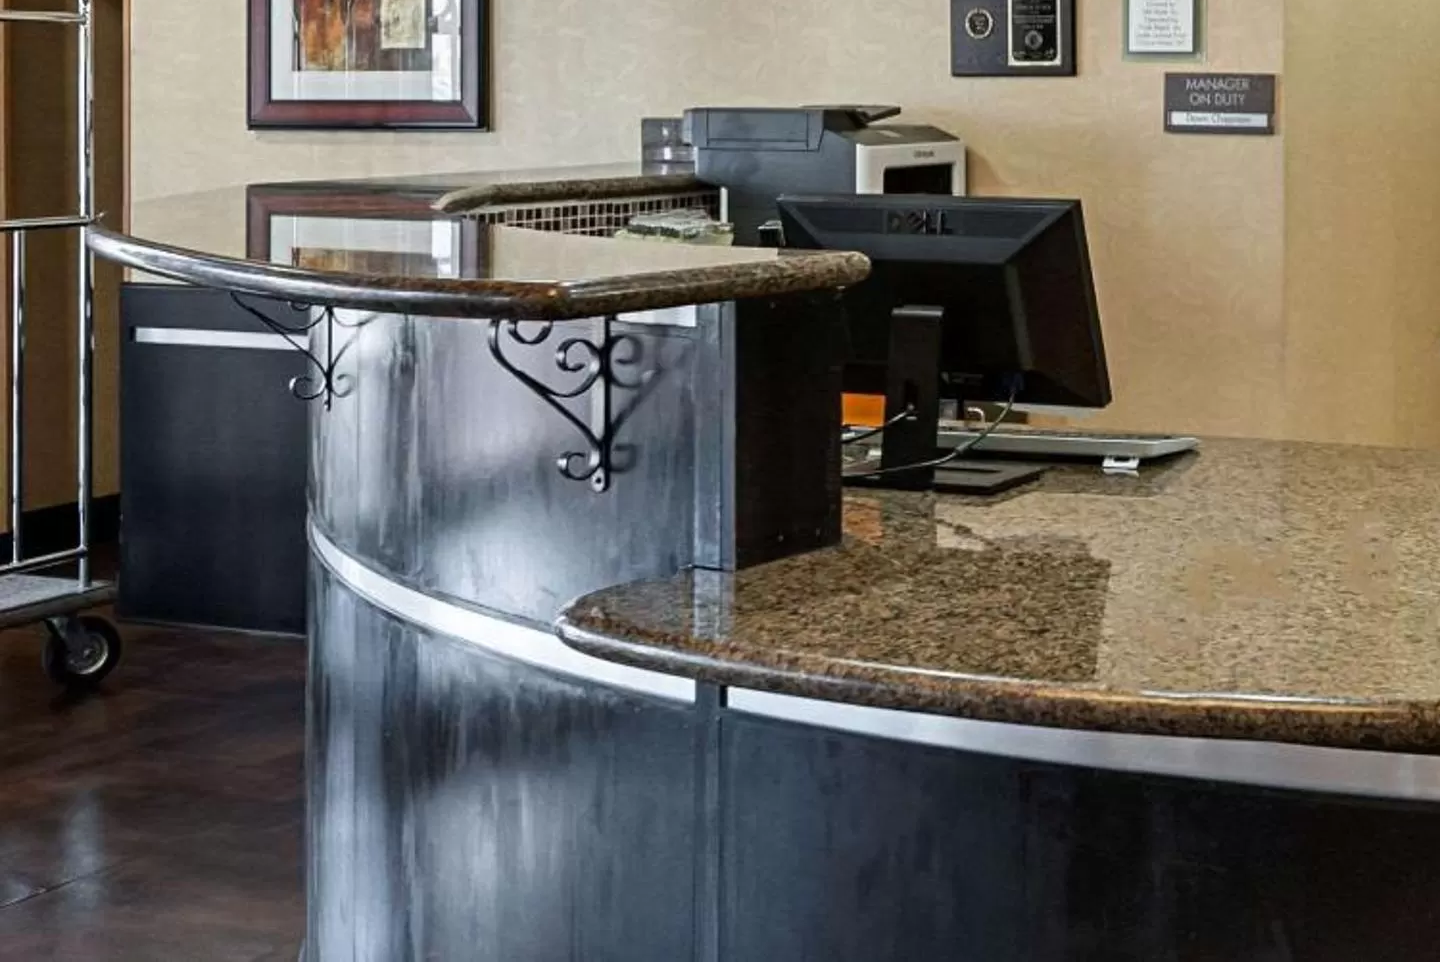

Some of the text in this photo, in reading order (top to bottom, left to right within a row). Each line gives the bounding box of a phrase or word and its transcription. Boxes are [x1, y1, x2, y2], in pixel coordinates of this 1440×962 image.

[1185, 77, 1251, 91] MANAGER
[1189, 92, 1246, 106] ON DUTY
[885, 209, 953, 235] DELL
